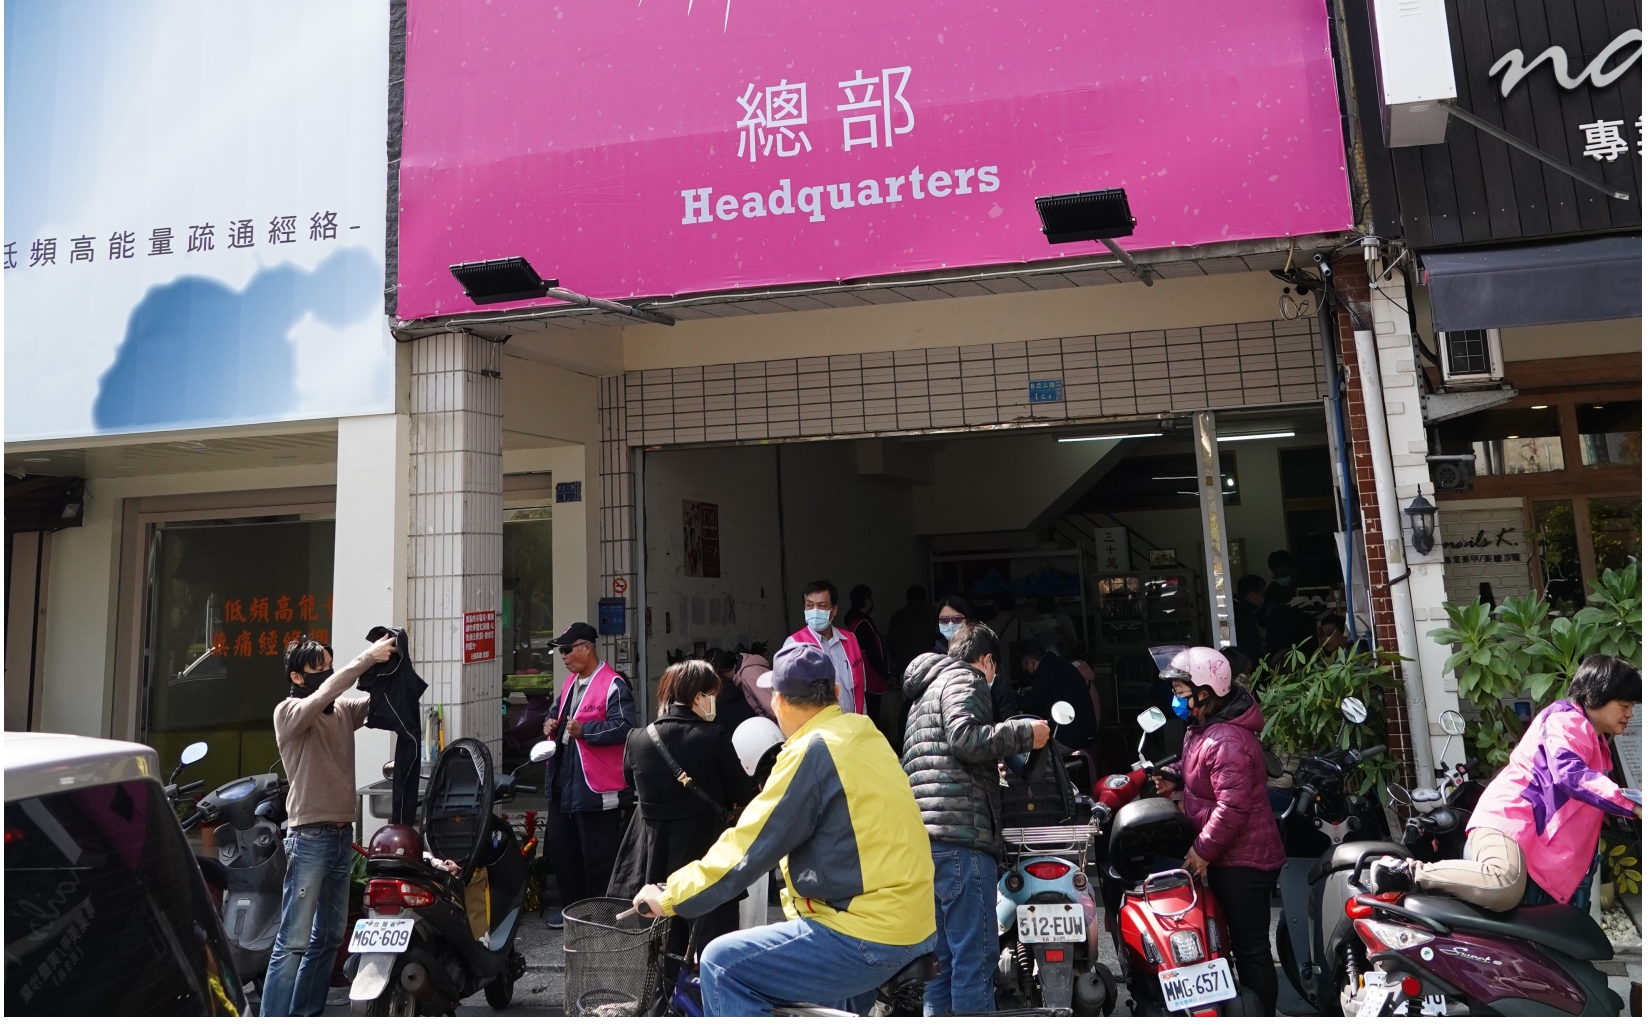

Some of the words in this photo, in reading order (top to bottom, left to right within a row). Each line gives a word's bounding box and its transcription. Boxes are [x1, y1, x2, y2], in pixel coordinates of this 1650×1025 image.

[735, 65, 915, 163] 總部
[680, 164, 1001, 226] Headquarters
[1442, 528, 1492, 550] nails
